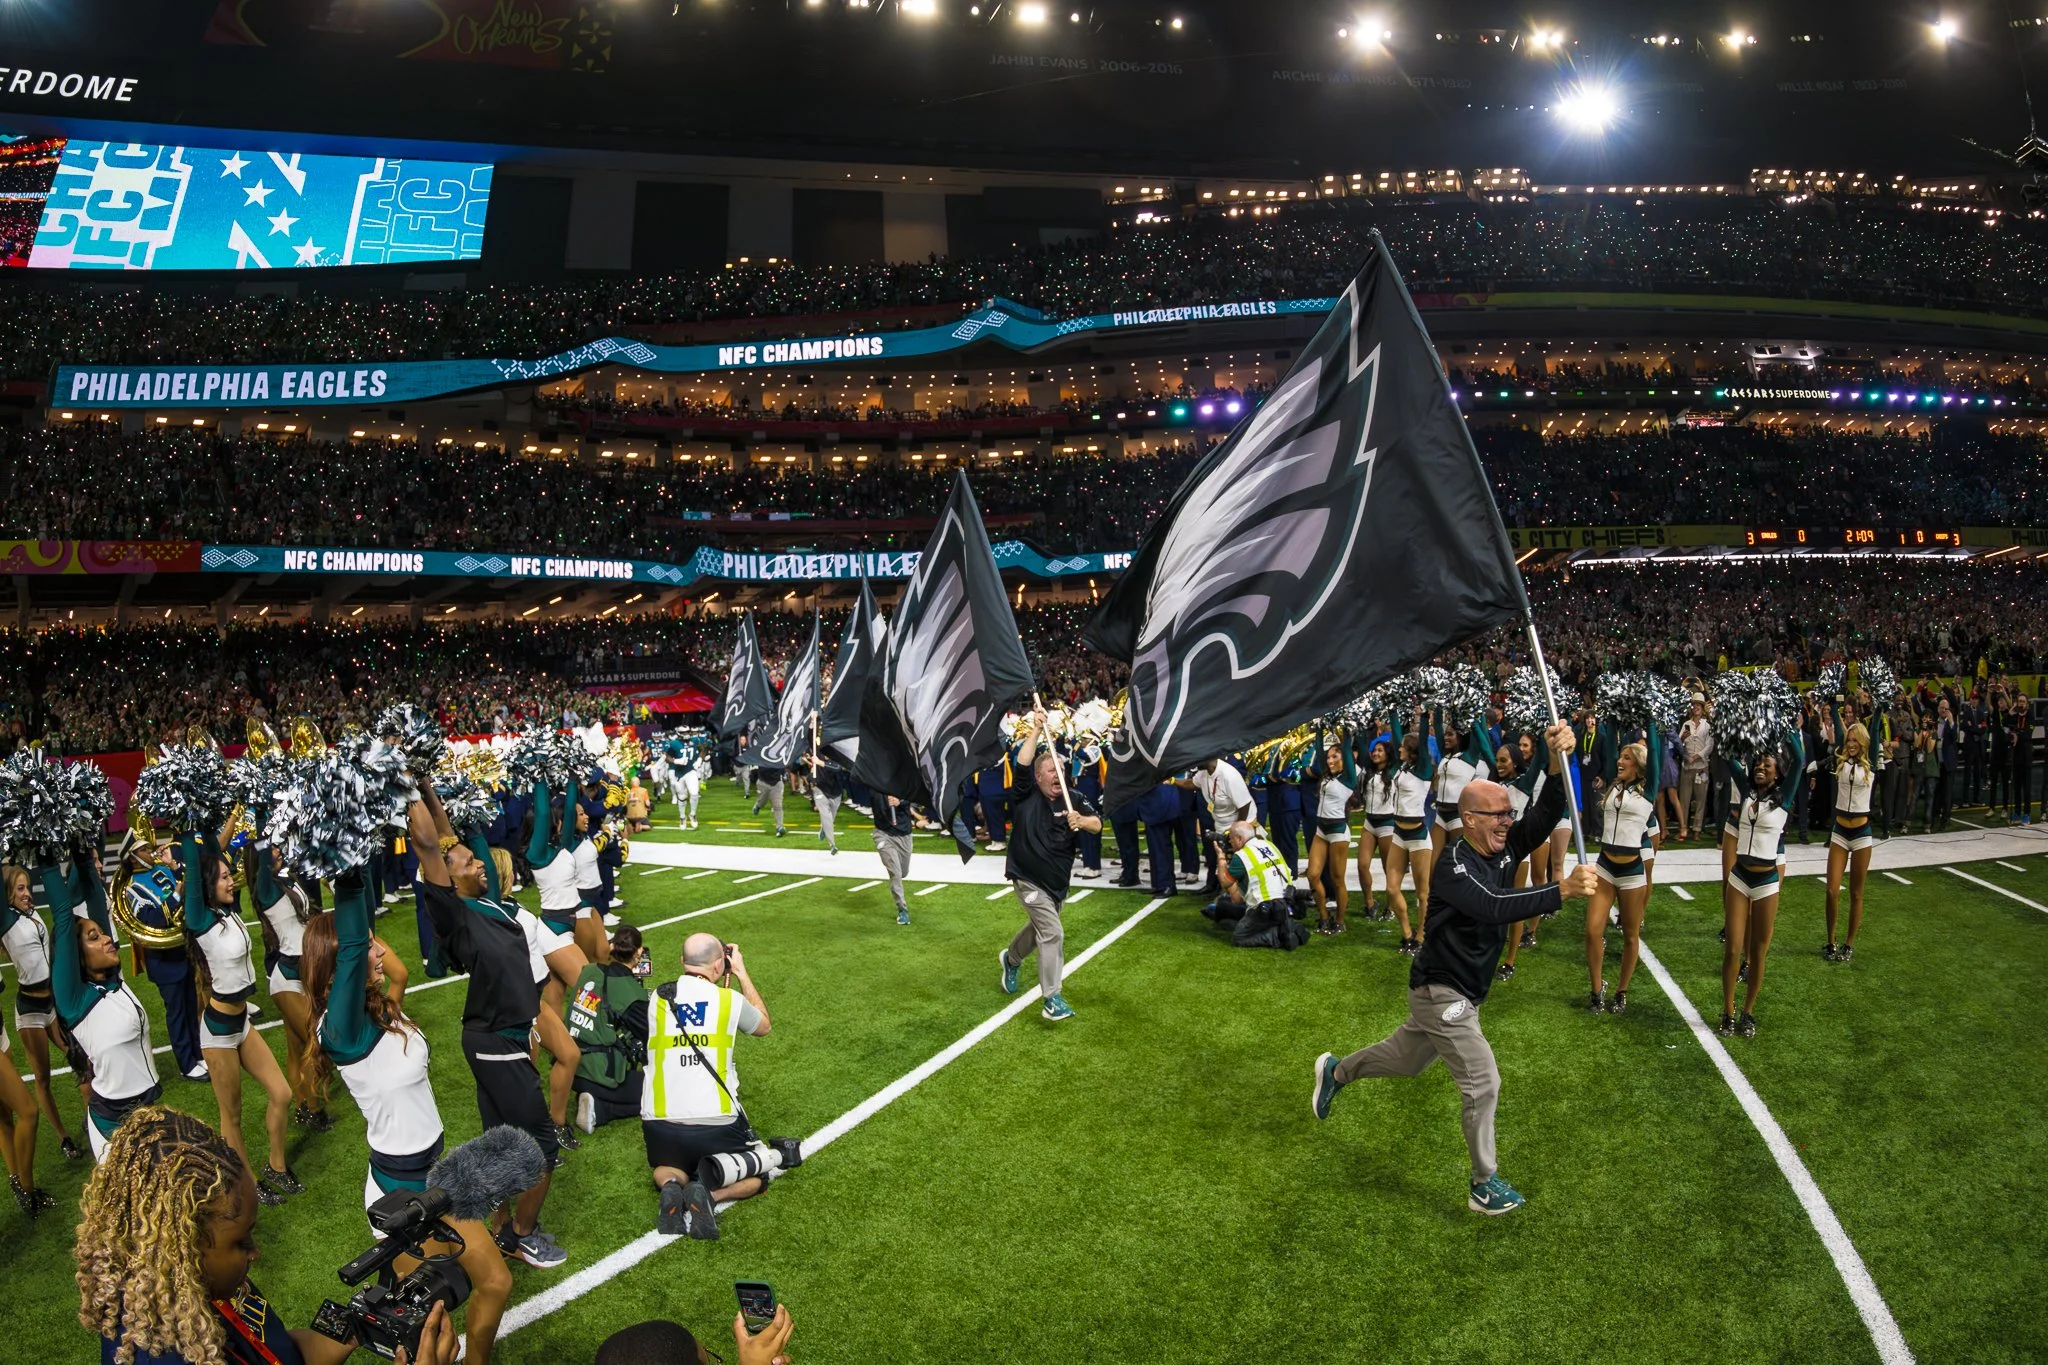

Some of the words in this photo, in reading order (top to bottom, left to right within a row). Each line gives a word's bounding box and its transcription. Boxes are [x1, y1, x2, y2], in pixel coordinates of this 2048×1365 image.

[989, 54, 1035, 66] JAHRI
[1039, 56, 1089, 70] EVANS
[1113, 304, 1218, 326] PHILADELPHIA
[1223, 301, 1277, 317] EAGLES
[718, 345, 757, 366] NFC
[763, 336, 884, 363] CHAMPIONS
[70, 371, 269, 401] PHILADELPHIA
[280, 369, 388, 399] EAGLES
[1724, 387, 1775, 399] CAESARS
[1776, 389, 1831, 399] SUPERDOME
[1529, 530, 1572, 547] CITY
[1583, 529, 1665, 546] CHIEFS
[1747, 532, 1755, 545] 3
[1798, 529, 1806, 542] 0
[1846, 530, 1874, 542] 21:09
[1916, 530, 1924, 543] 0
[1953, 533, 1960, 546] 3
[284, 550, 317, 570] NFC
[322, 551, 424, 573] CHAMPIONS
[511, 557, 541, 576] NFC
[545, 558, 633, 579] CHAMPIONS
[723, 552, 889, 579] PHILADELPHIA
[1103, 553, 1132, 570] NFC
[627, 671, 681, 681] SUPERDOME
[570, 1009, 594, 1032] EDIA
[680, 1054, 700, 1067] 019
